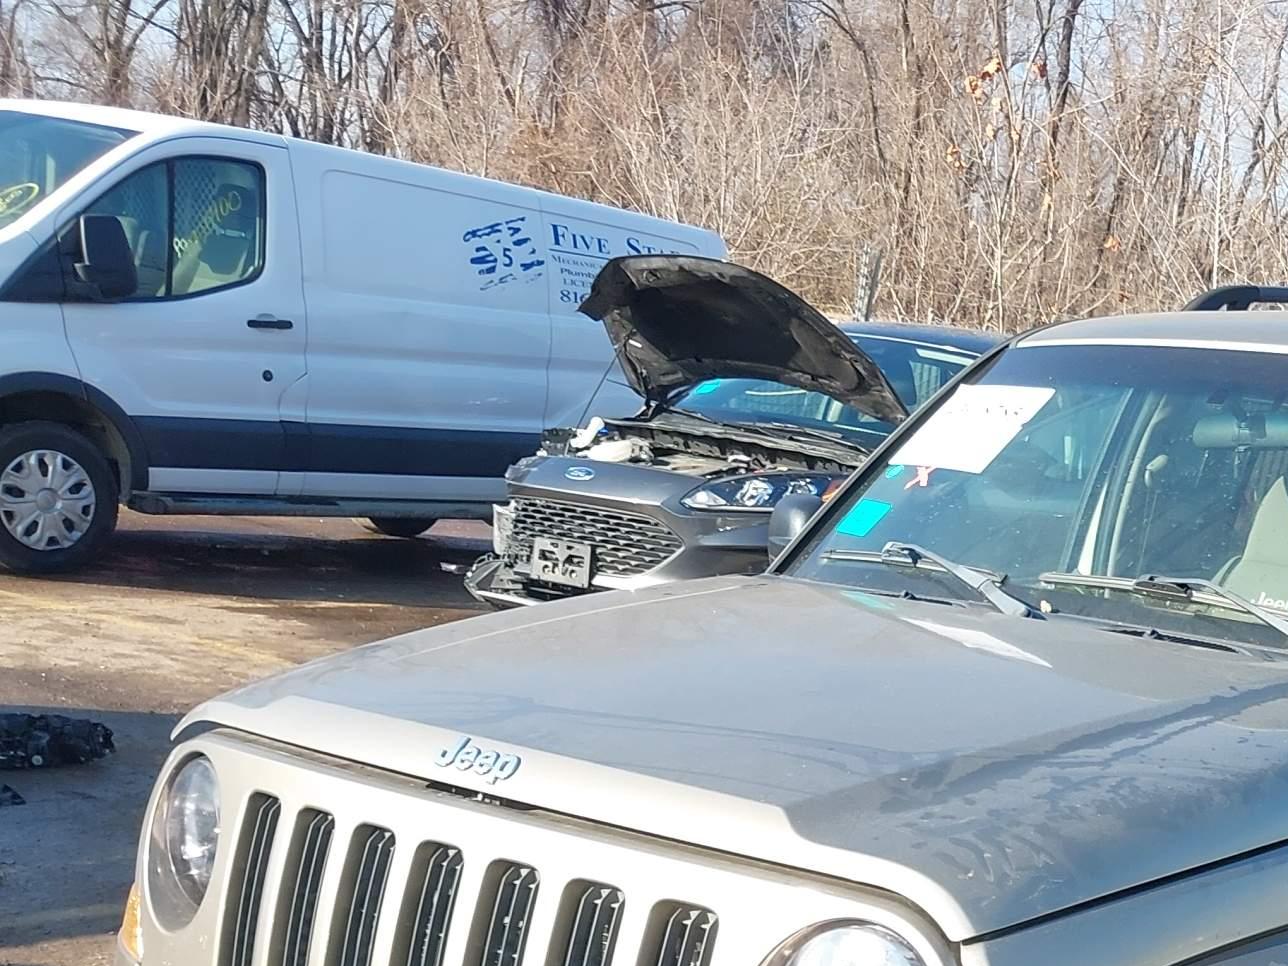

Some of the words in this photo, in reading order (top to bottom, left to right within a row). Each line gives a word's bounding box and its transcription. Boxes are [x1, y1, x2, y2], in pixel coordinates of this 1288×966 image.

[626, 236, 681, 256] ST
[502, 247, 514, 268] 5
[435, 736, 522, 785] Jeep
